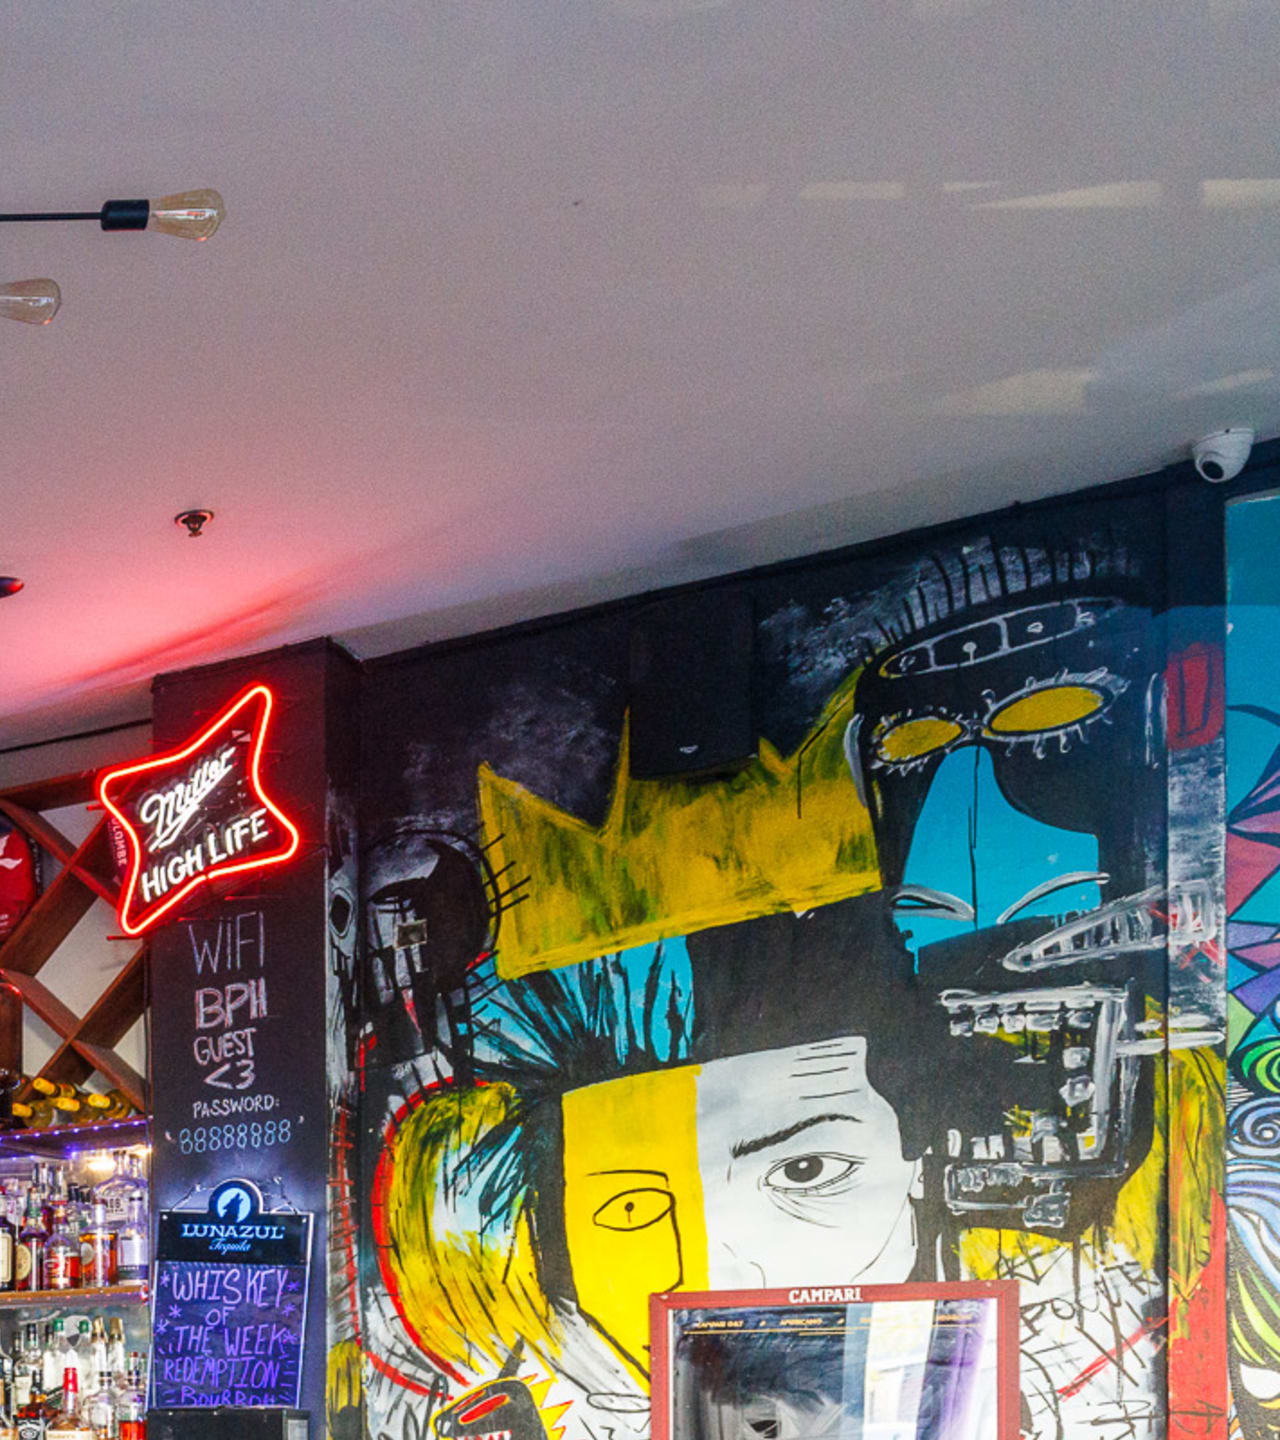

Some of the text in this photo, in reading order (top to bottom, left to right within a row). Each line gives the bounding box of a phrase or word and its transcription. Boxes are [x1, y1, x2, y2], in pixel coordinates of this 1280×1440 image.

[139, 746, 237, 846] Miller
[141, 808, 269, 903] HIGH LIFE
[195, 978, 269, 1031] BPH
[193, 1026, 257, 1066] GUEST
[203, 1060, 256, 1091] <3
[192, 1094, 281, 1119] PASSWORD:
[179, 1118, 292, 1155] 88888888
[182, 1223, 284, 1240] LUNAZUL
[208, 1239, 252, 1256] Tequila
[172, 1268, 289, 1309] WHISKEY
[788, 1286, 862, 1304] CAMPARI
[205, 1306, 236, 1327] OF
[173, 1324, 285, 1356] THE WEEK
[163, 1355, 281, 1389] REDEMPTION
